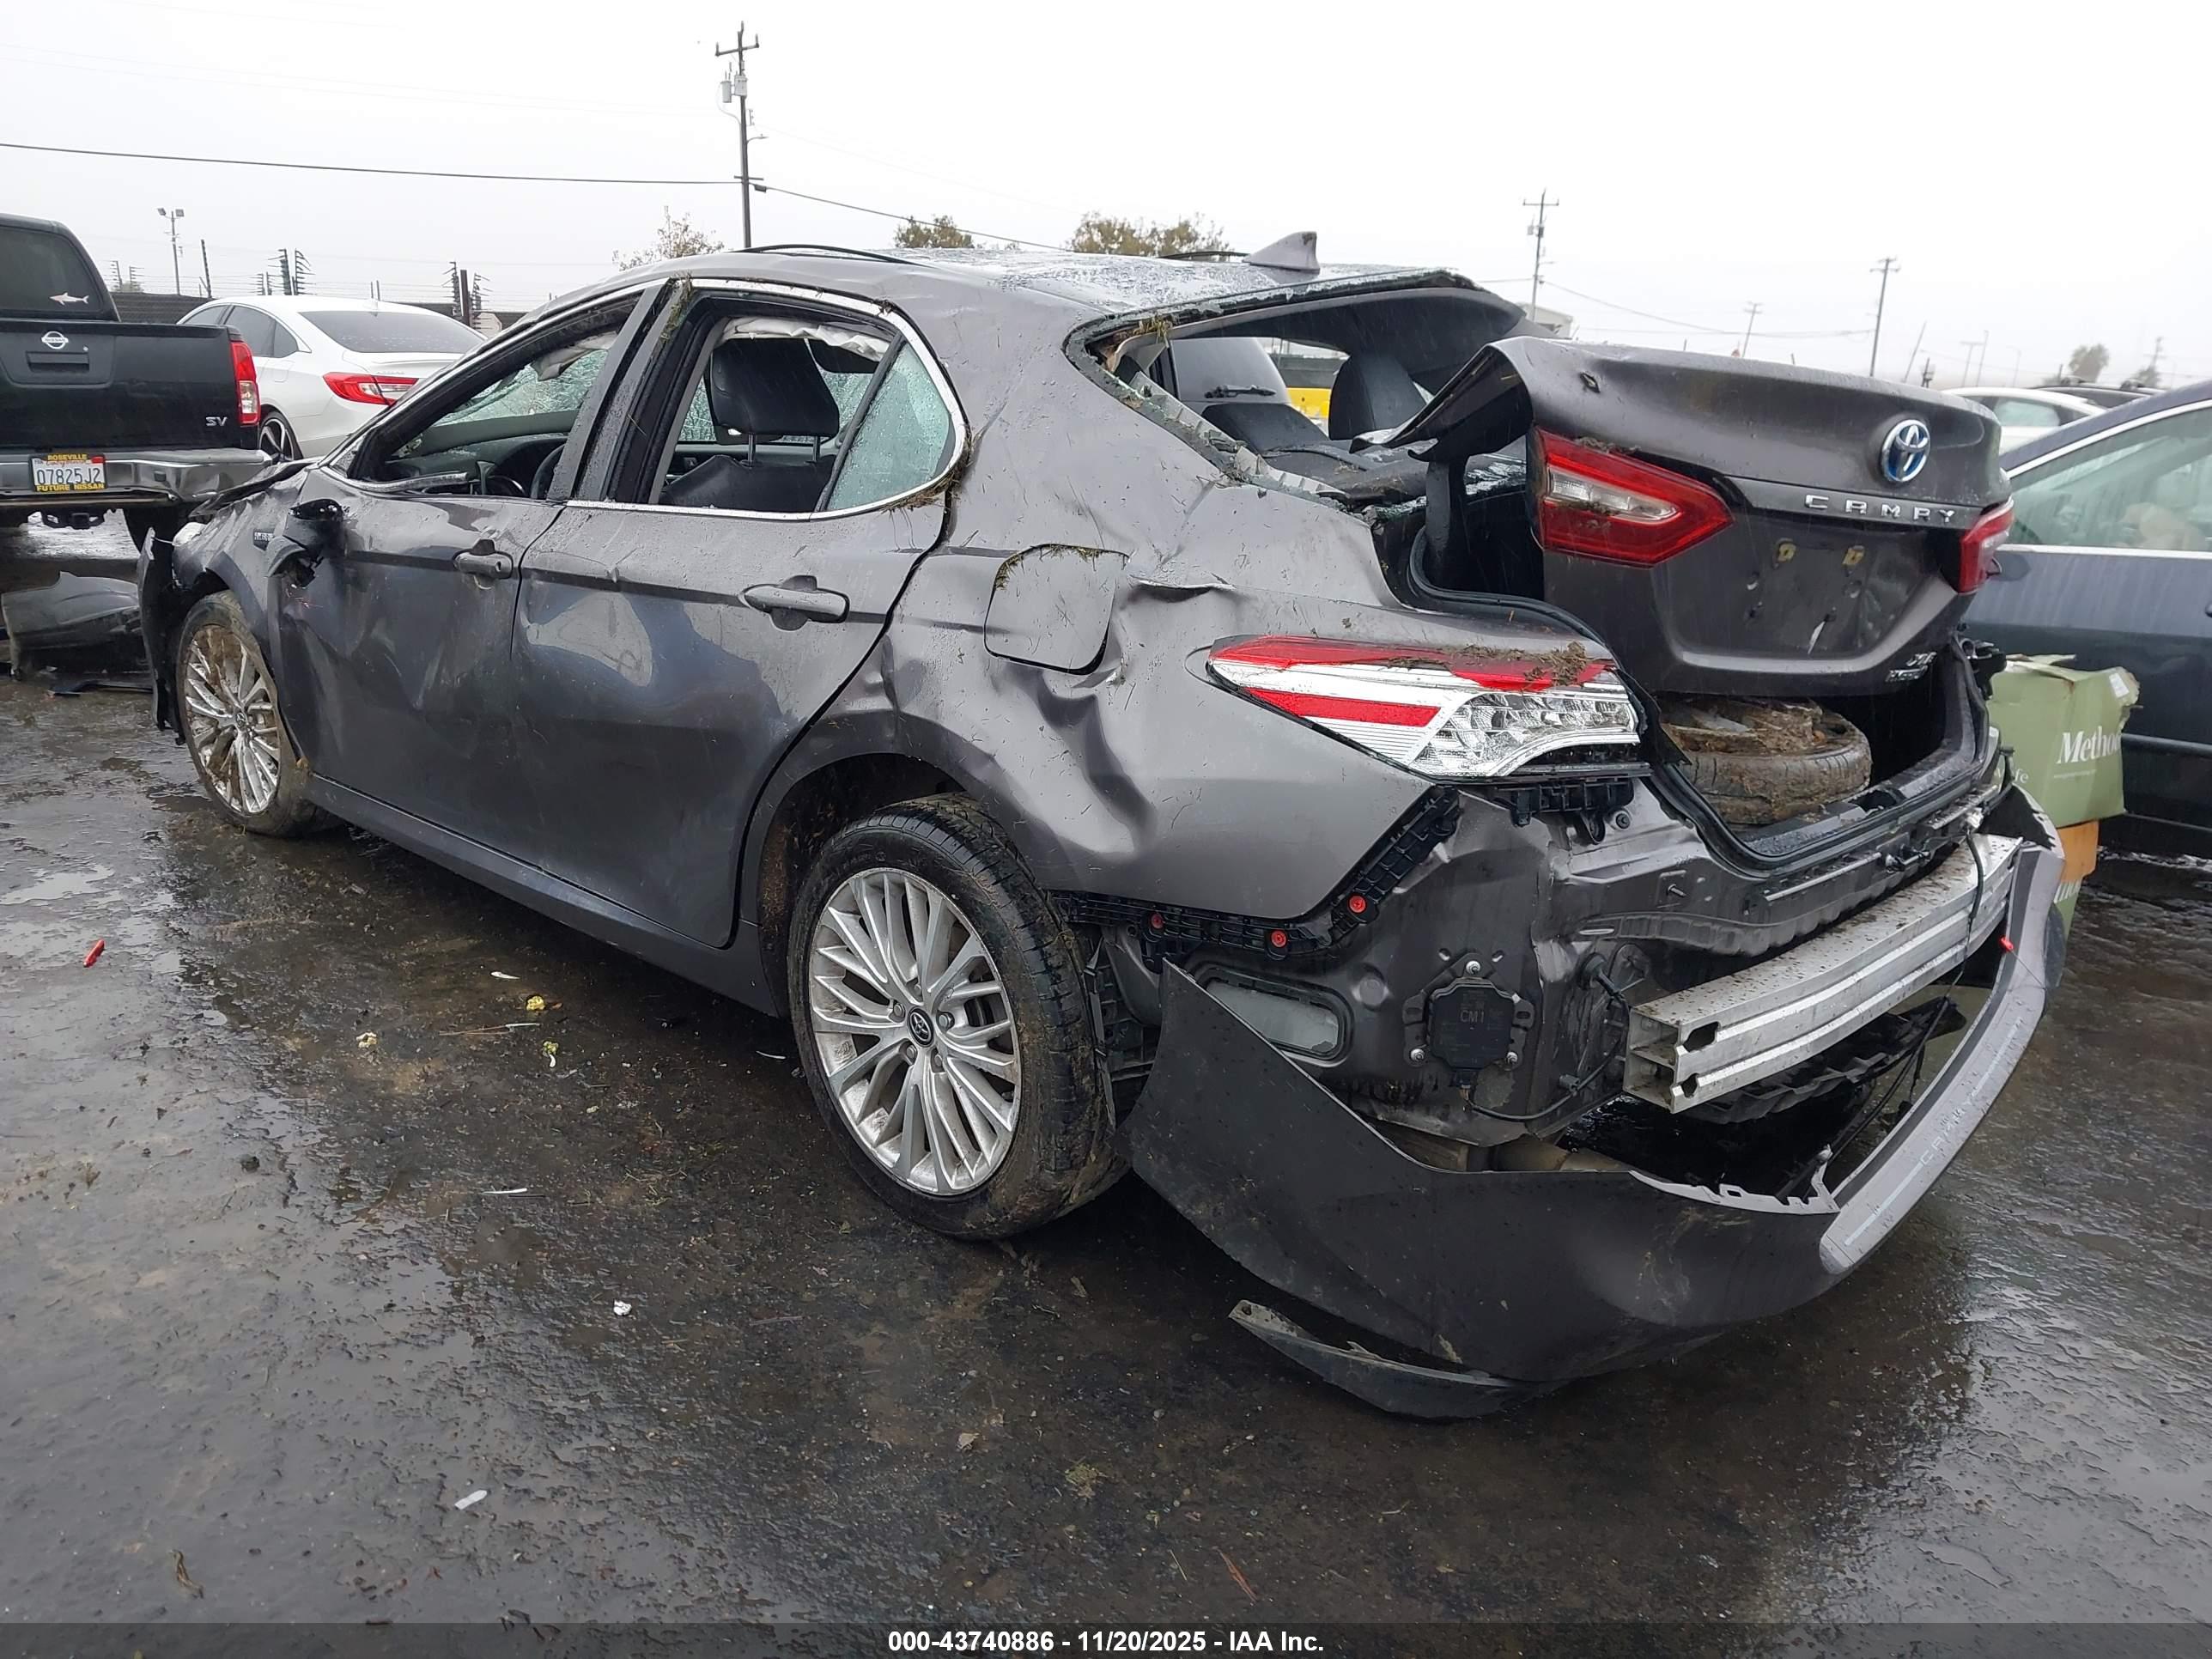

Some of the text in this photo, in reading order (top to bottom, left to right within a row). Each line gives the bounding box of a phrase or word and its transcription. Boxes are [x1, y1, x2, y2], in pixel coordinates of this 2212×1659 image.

[206, 416, 228, 427] SV
[37, 468, 102, 484] 07825J2
[1805, 495, 1955, 523] CAMRY
